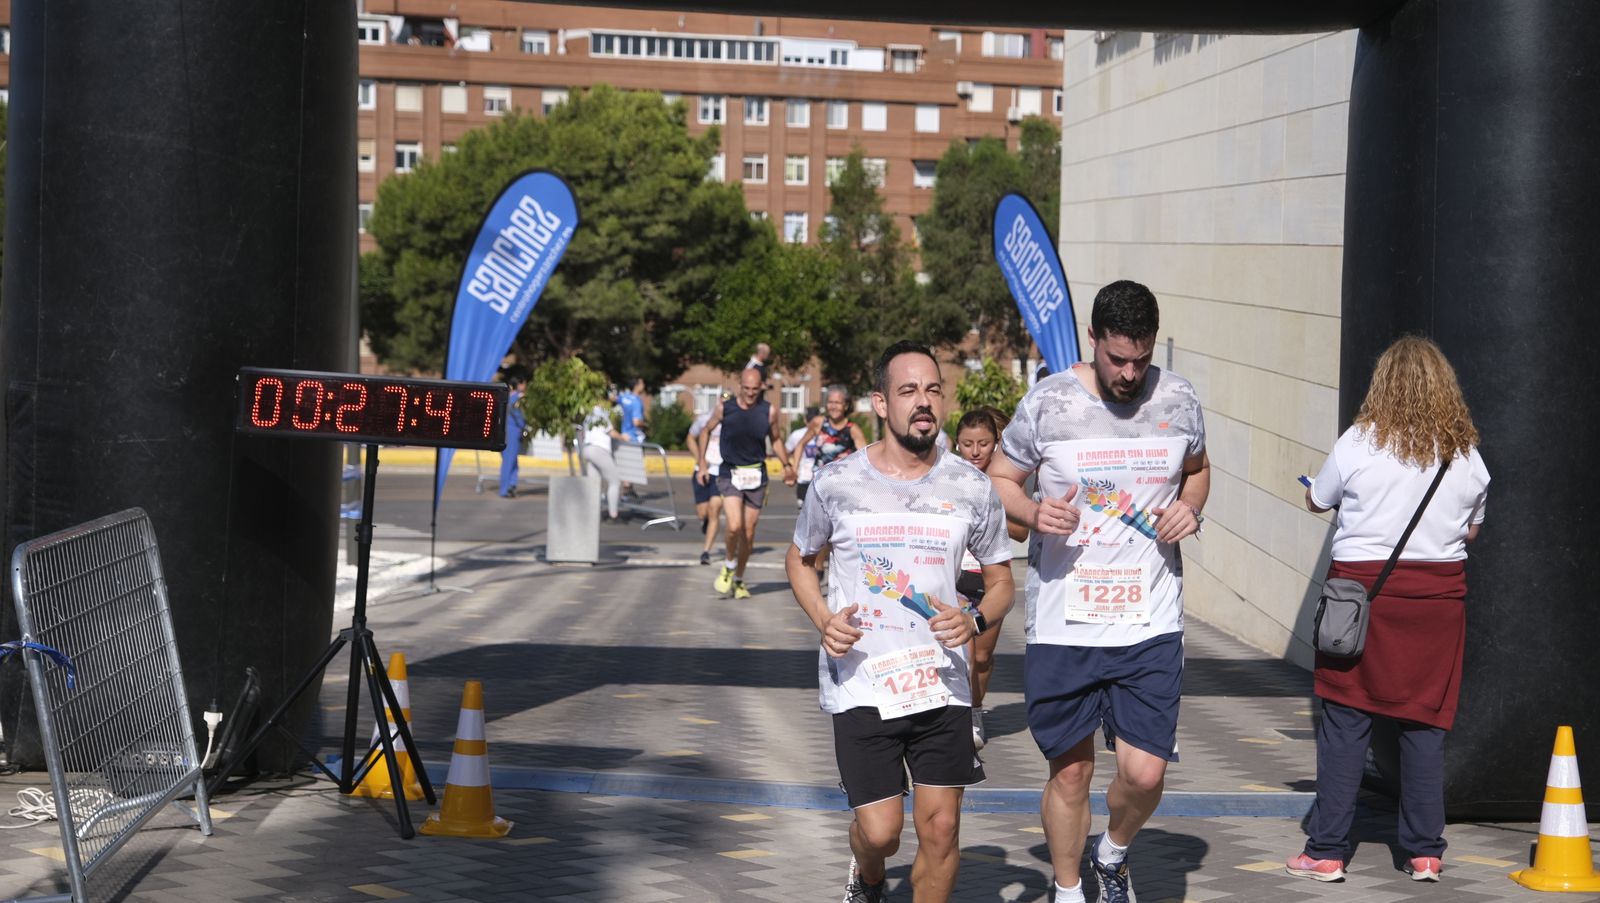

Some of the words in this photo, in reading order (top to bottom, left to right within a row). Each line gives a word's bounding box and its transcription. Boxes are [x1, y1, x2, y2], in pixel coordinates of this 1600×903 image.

[251, 376, 495, 438] 00:27:47
[1086, 450, 1126, 460] CARRERA
[1127, 449, 1143, 459] SIN
[1145, 448, 1169, 457] HUMO
[1145, 476, 1168, 485] JUNIO
[864, 525, 905, 536] CARRERA
[907, 526, 924, 536] SIN
[926, 527, 951, 538] HUMO
[913, 555, 920, 564] 4
[922, 555, 946, 566] JUNIO
[1078, 584, 1142, 604] 1228
[883, 665, 939, 695] 1229
